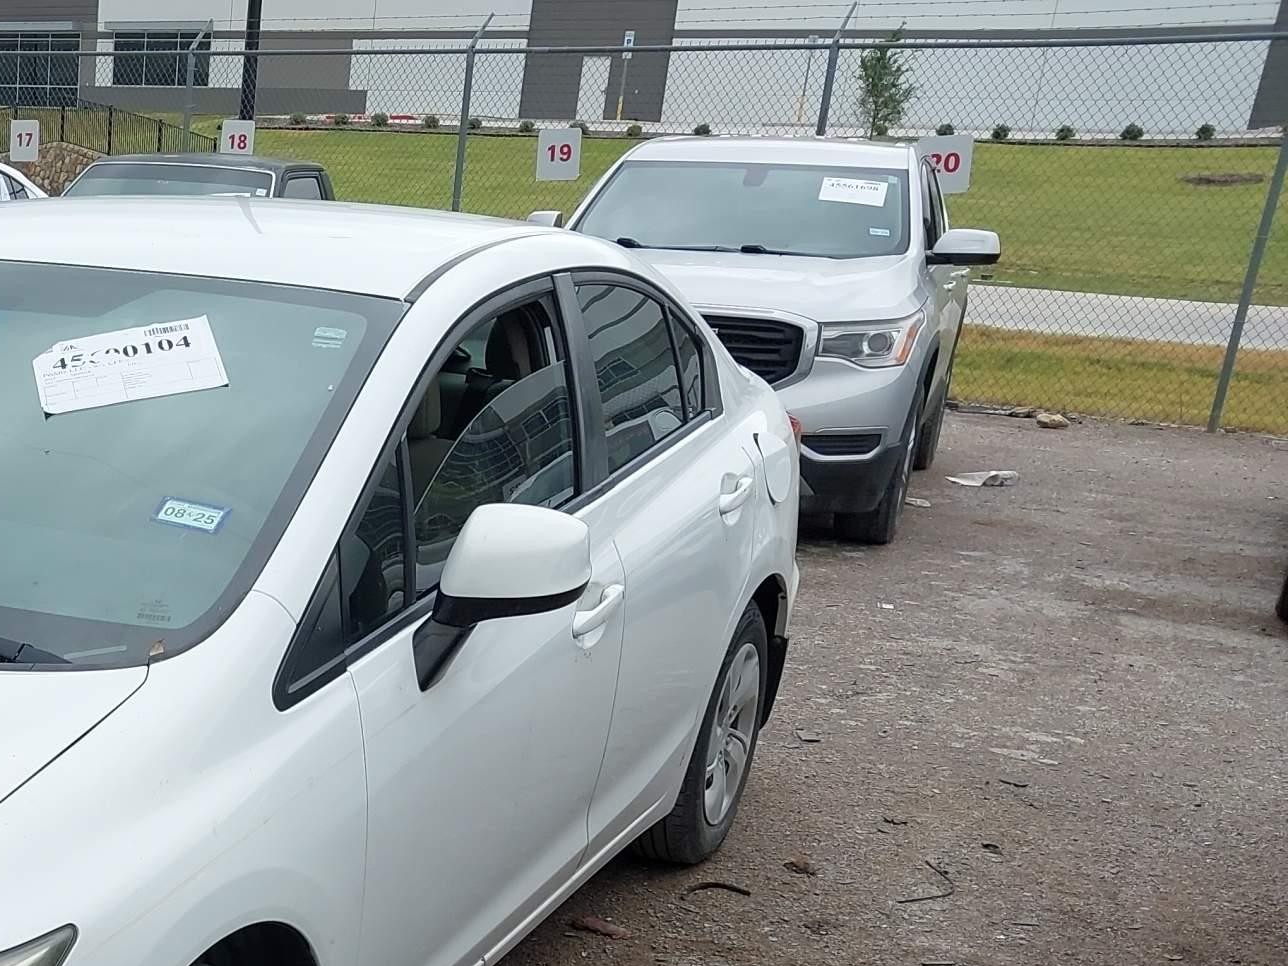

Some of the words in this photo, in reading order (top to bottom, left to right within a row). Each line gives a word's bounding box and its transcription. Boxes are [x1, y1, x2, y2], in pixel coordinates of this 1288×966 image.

[17, 132, 33, 147] 17
[228, 134, 247, 150] 18
[547, 144, 572, 162] 19
[930, 152, 961, 173] 20
